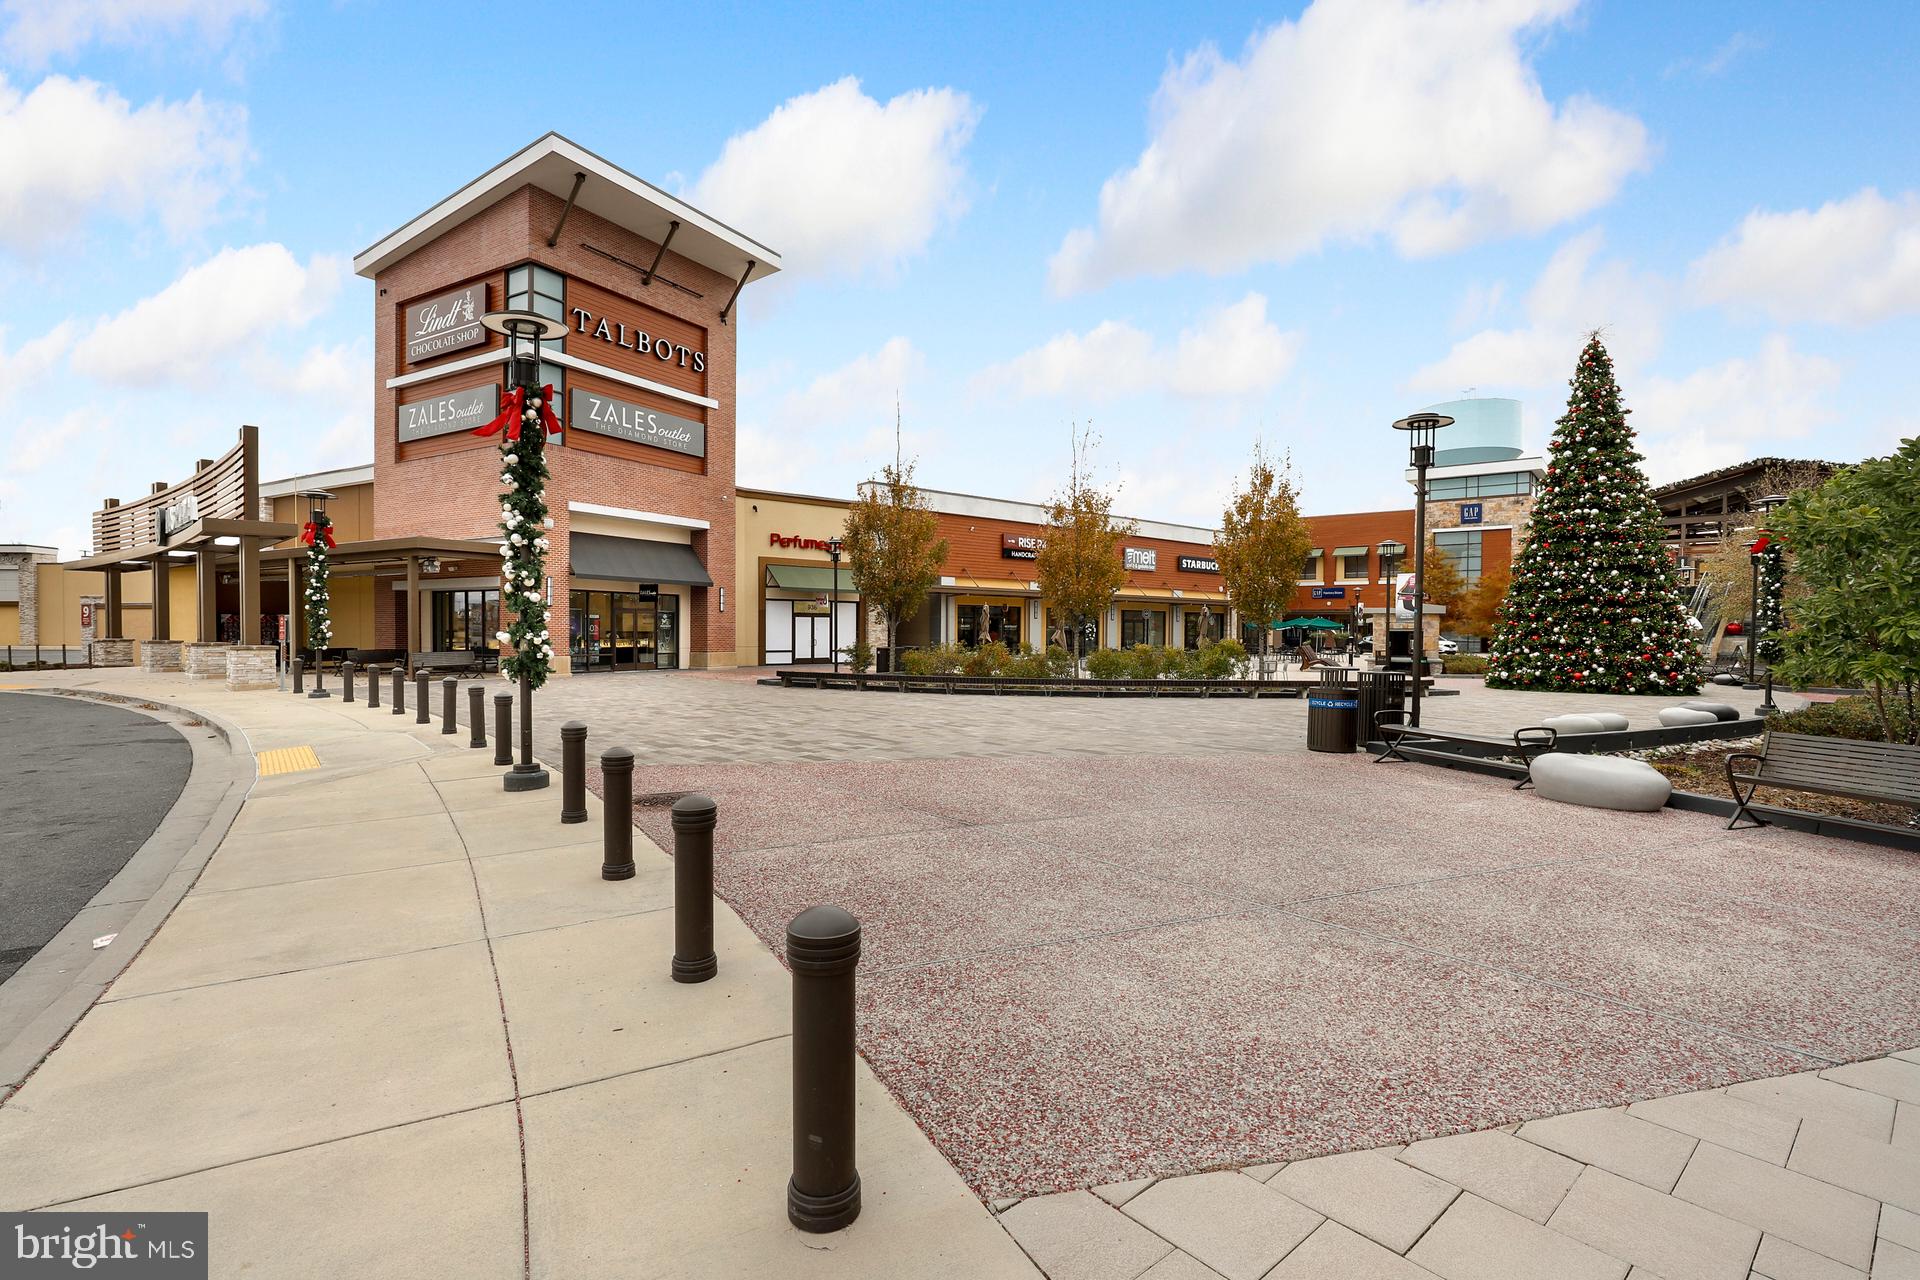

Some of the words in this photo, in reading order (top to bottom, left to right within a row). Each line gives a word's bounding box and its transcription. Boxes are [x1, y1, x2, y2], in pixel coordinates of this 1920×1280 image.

[415, 299, 462, 336] Lindt
[411, 334, 455, 357] CHOCOLATE
[456, 327, 479, 344] SHOP
[572, 307, 704, 372] TALBOTS
[409, 398, 455, 428] ZALES
[456, 398, 485, 419] outlet
[589, 398, 657, 434] ZALES
[658, 427, 692, 443] outlet
[594, 422, 611, 432] THE
[618, 428, 659, 443] DIAMOND
[663, 438, 688, 449] STORE
[1464, 507, 1479, 517] GAP
[1018, 537, 1036, 549] RISE
[1011, 550, 1037, 559] HANDCRA
[1133, 550, 1156, 565] melt
[1182, 559, 1220, 571] STARBUCK
[82, 606, 89, 617] 9
